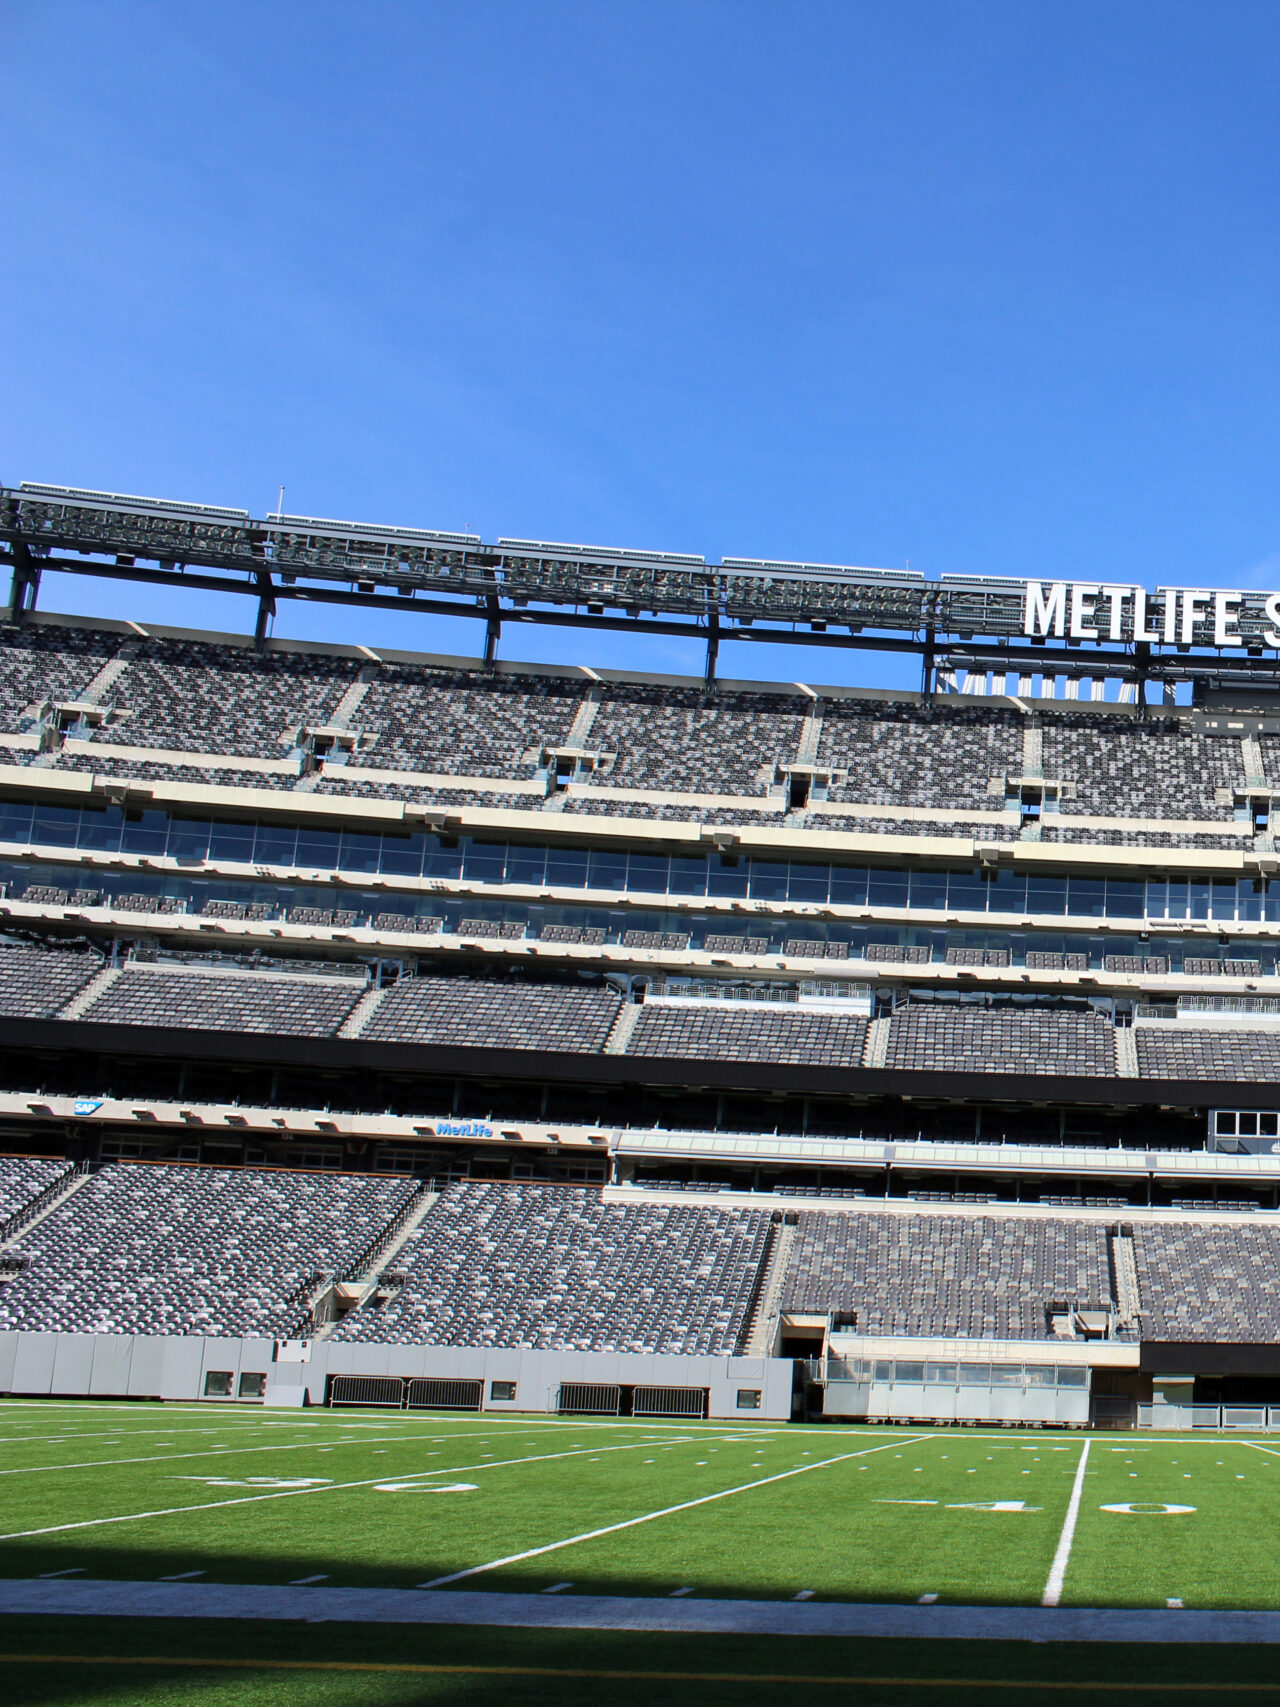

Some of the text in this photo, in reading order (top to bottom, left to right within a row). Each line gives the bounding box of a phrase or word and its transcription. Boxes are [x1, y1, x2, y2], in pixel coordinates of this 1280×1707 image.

[1024, 582, 1242, 646] METLIFE
[74, 1102, 96, 1112] SAP
[436, 1122, 494, 1137] MetLife
